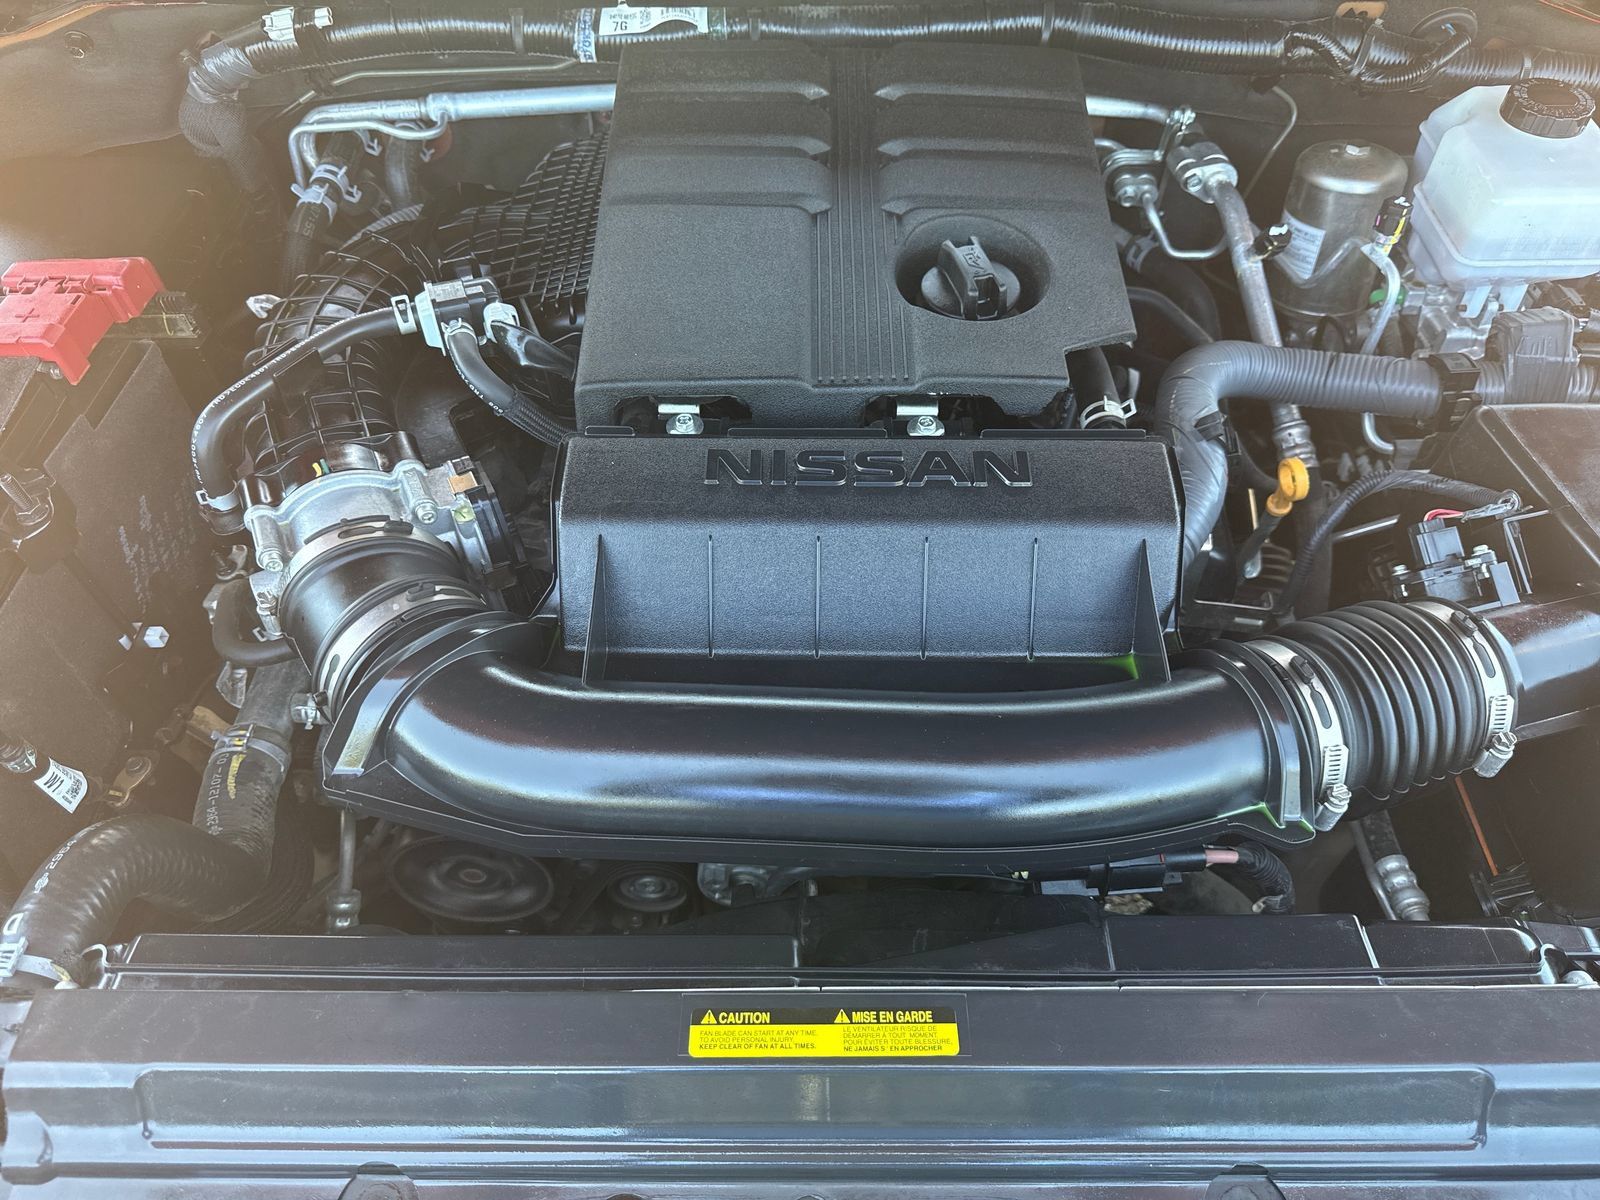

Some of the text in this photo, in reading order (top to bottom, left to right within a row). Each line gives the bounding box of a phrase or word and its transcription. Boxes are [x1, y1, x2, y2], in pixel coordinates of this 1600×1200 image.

[612, 20, 628, 32] 7G
[703, 448, 1034, 488] NISSAN
[43, 771, 65, 793] W1
[719, 1012, 770, 1024] CAUTION
[852, 1011, 933, 1023] MISE EN GARDE
